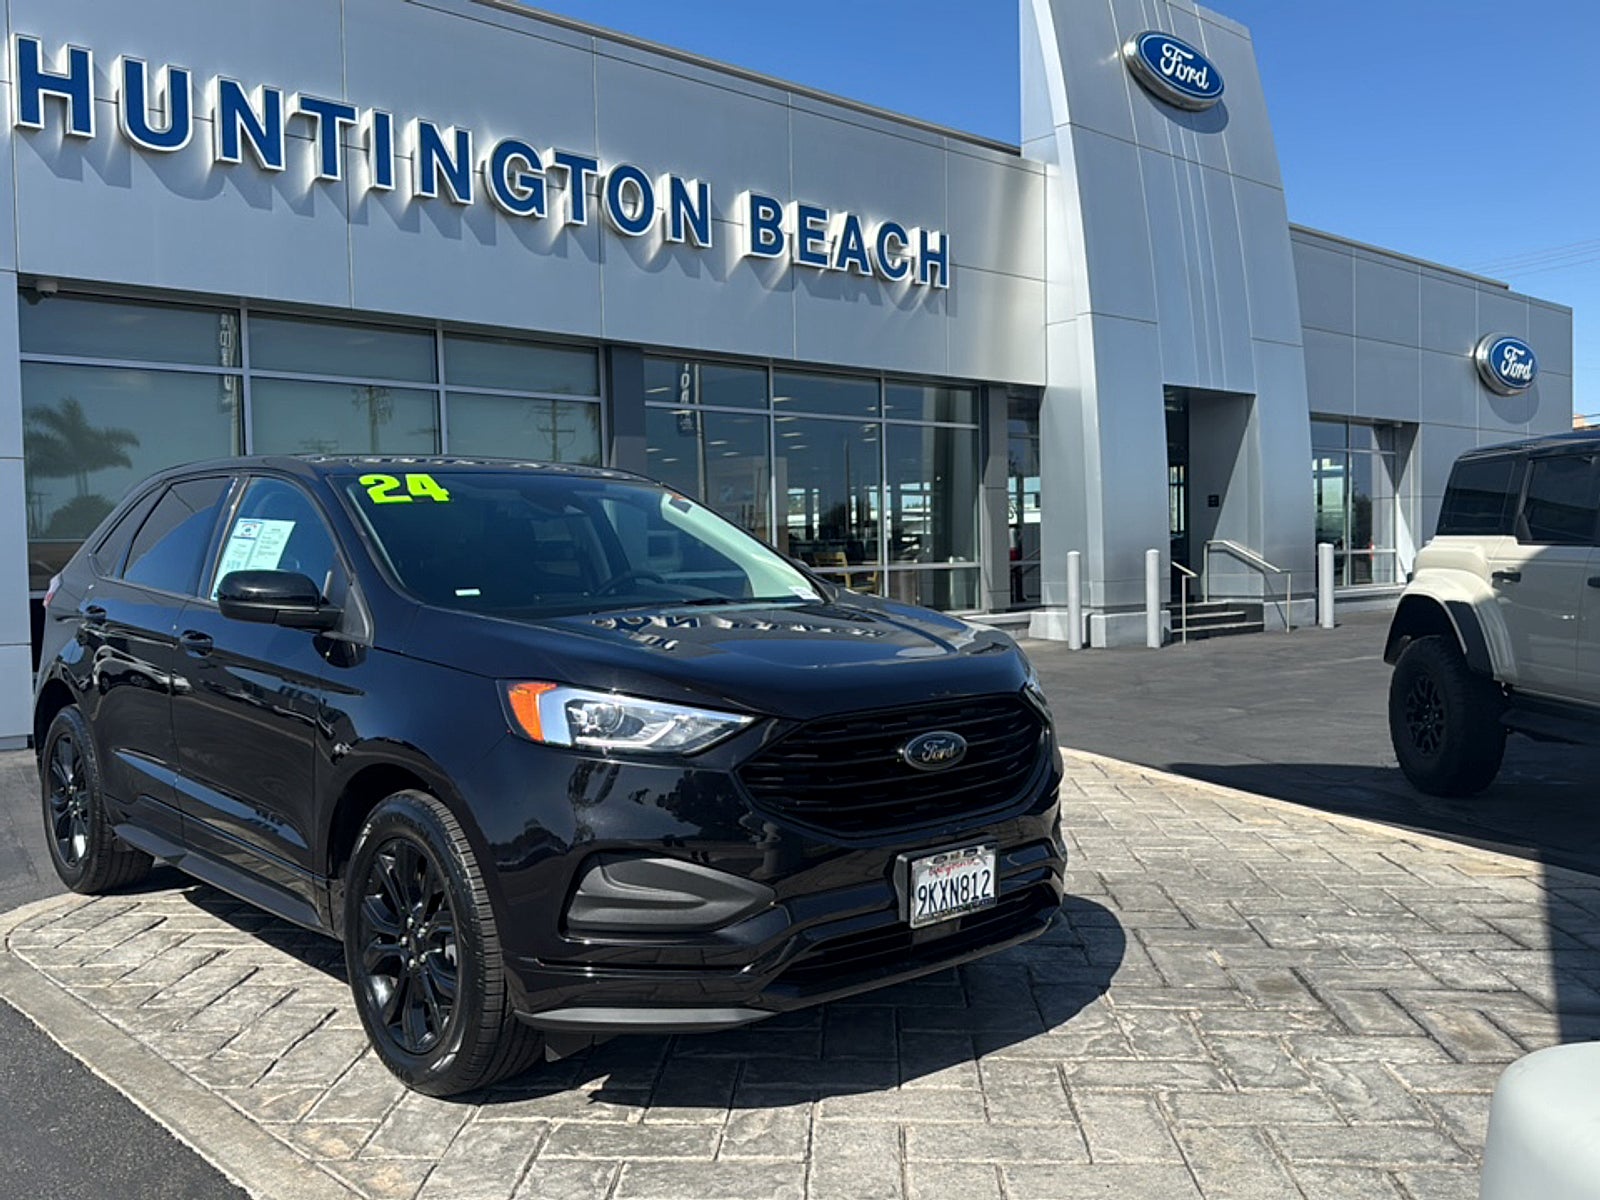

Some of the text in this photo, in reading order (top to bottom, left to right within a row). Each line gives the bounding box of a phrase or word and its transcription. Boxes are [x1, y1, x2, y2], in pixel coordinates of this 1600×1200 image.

[1160, 43, 1210, 90] Ford
[15, 35, 950, 289] HUNTINGTON BEACH
[1500, 345, 1533, 380] Ford
[358, 473, 450, 504] 24
[922, 739, 955, 762] Ford
[918, 869, 992, 918] 9KXN812
